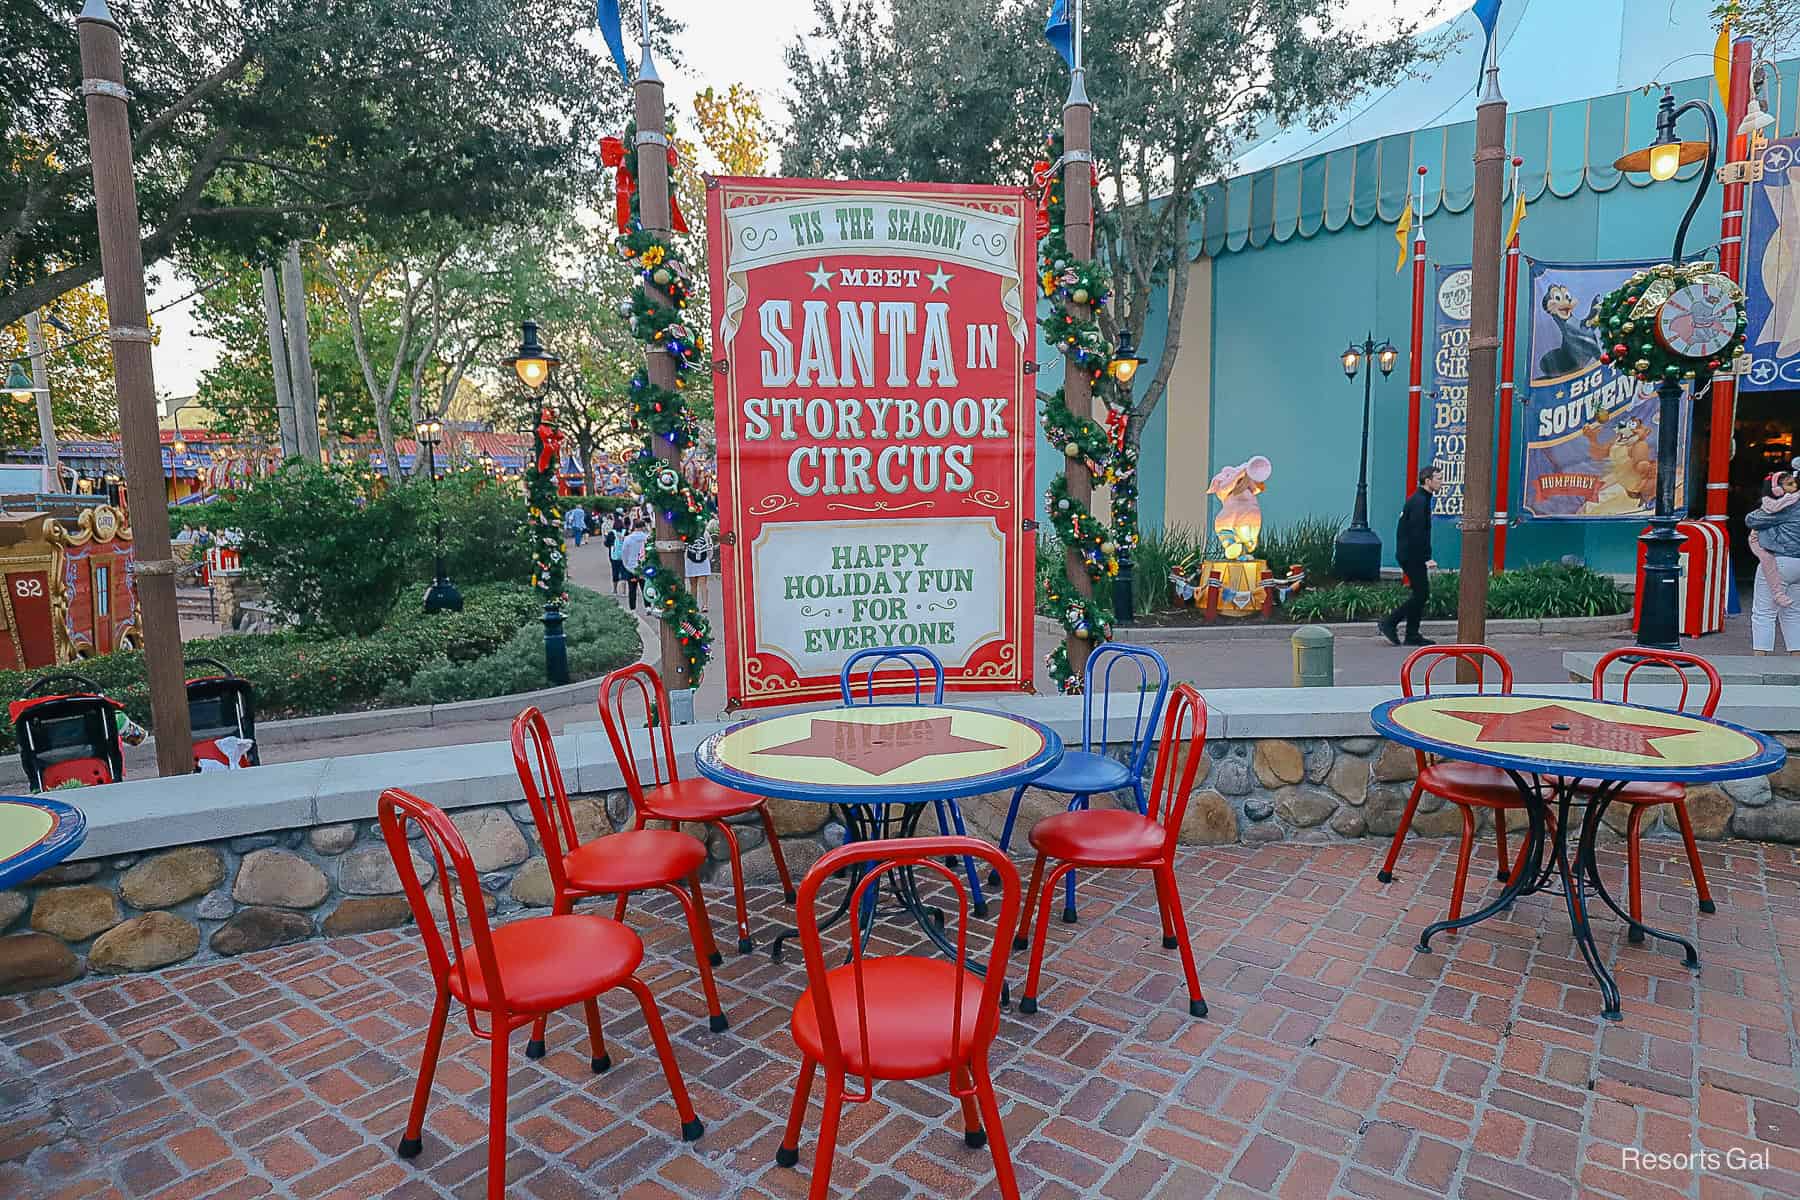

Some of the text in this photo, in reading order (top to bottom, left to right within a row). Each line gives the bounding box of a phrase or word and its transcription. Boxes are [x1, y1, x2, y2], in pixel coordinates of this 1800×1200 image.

[836, 207, 874, 239] THE
[887, 209, 967, 250] SEASON!
[839, 268, 920, 288] MEET
[758, 299, 998, 389] SANTA IN
[1570, 370, 1603, 398] BIG
[743, 397, 1010, 441] STORYBOOK
[1538, 375, 1636, 437] SOUVEN
[787, 444, 975, 497] CIRCUS
[1540, 475, 1595, 489] HUMPHREY
[831, 543, 929, 570] HAPPY
[15, 579, 43, 597] 82
[783, 568, 974, 600] HOLIDAY FUN
[851, 597, 908, 622] FOR
[804, 621, 956, 653] EVERYONE
